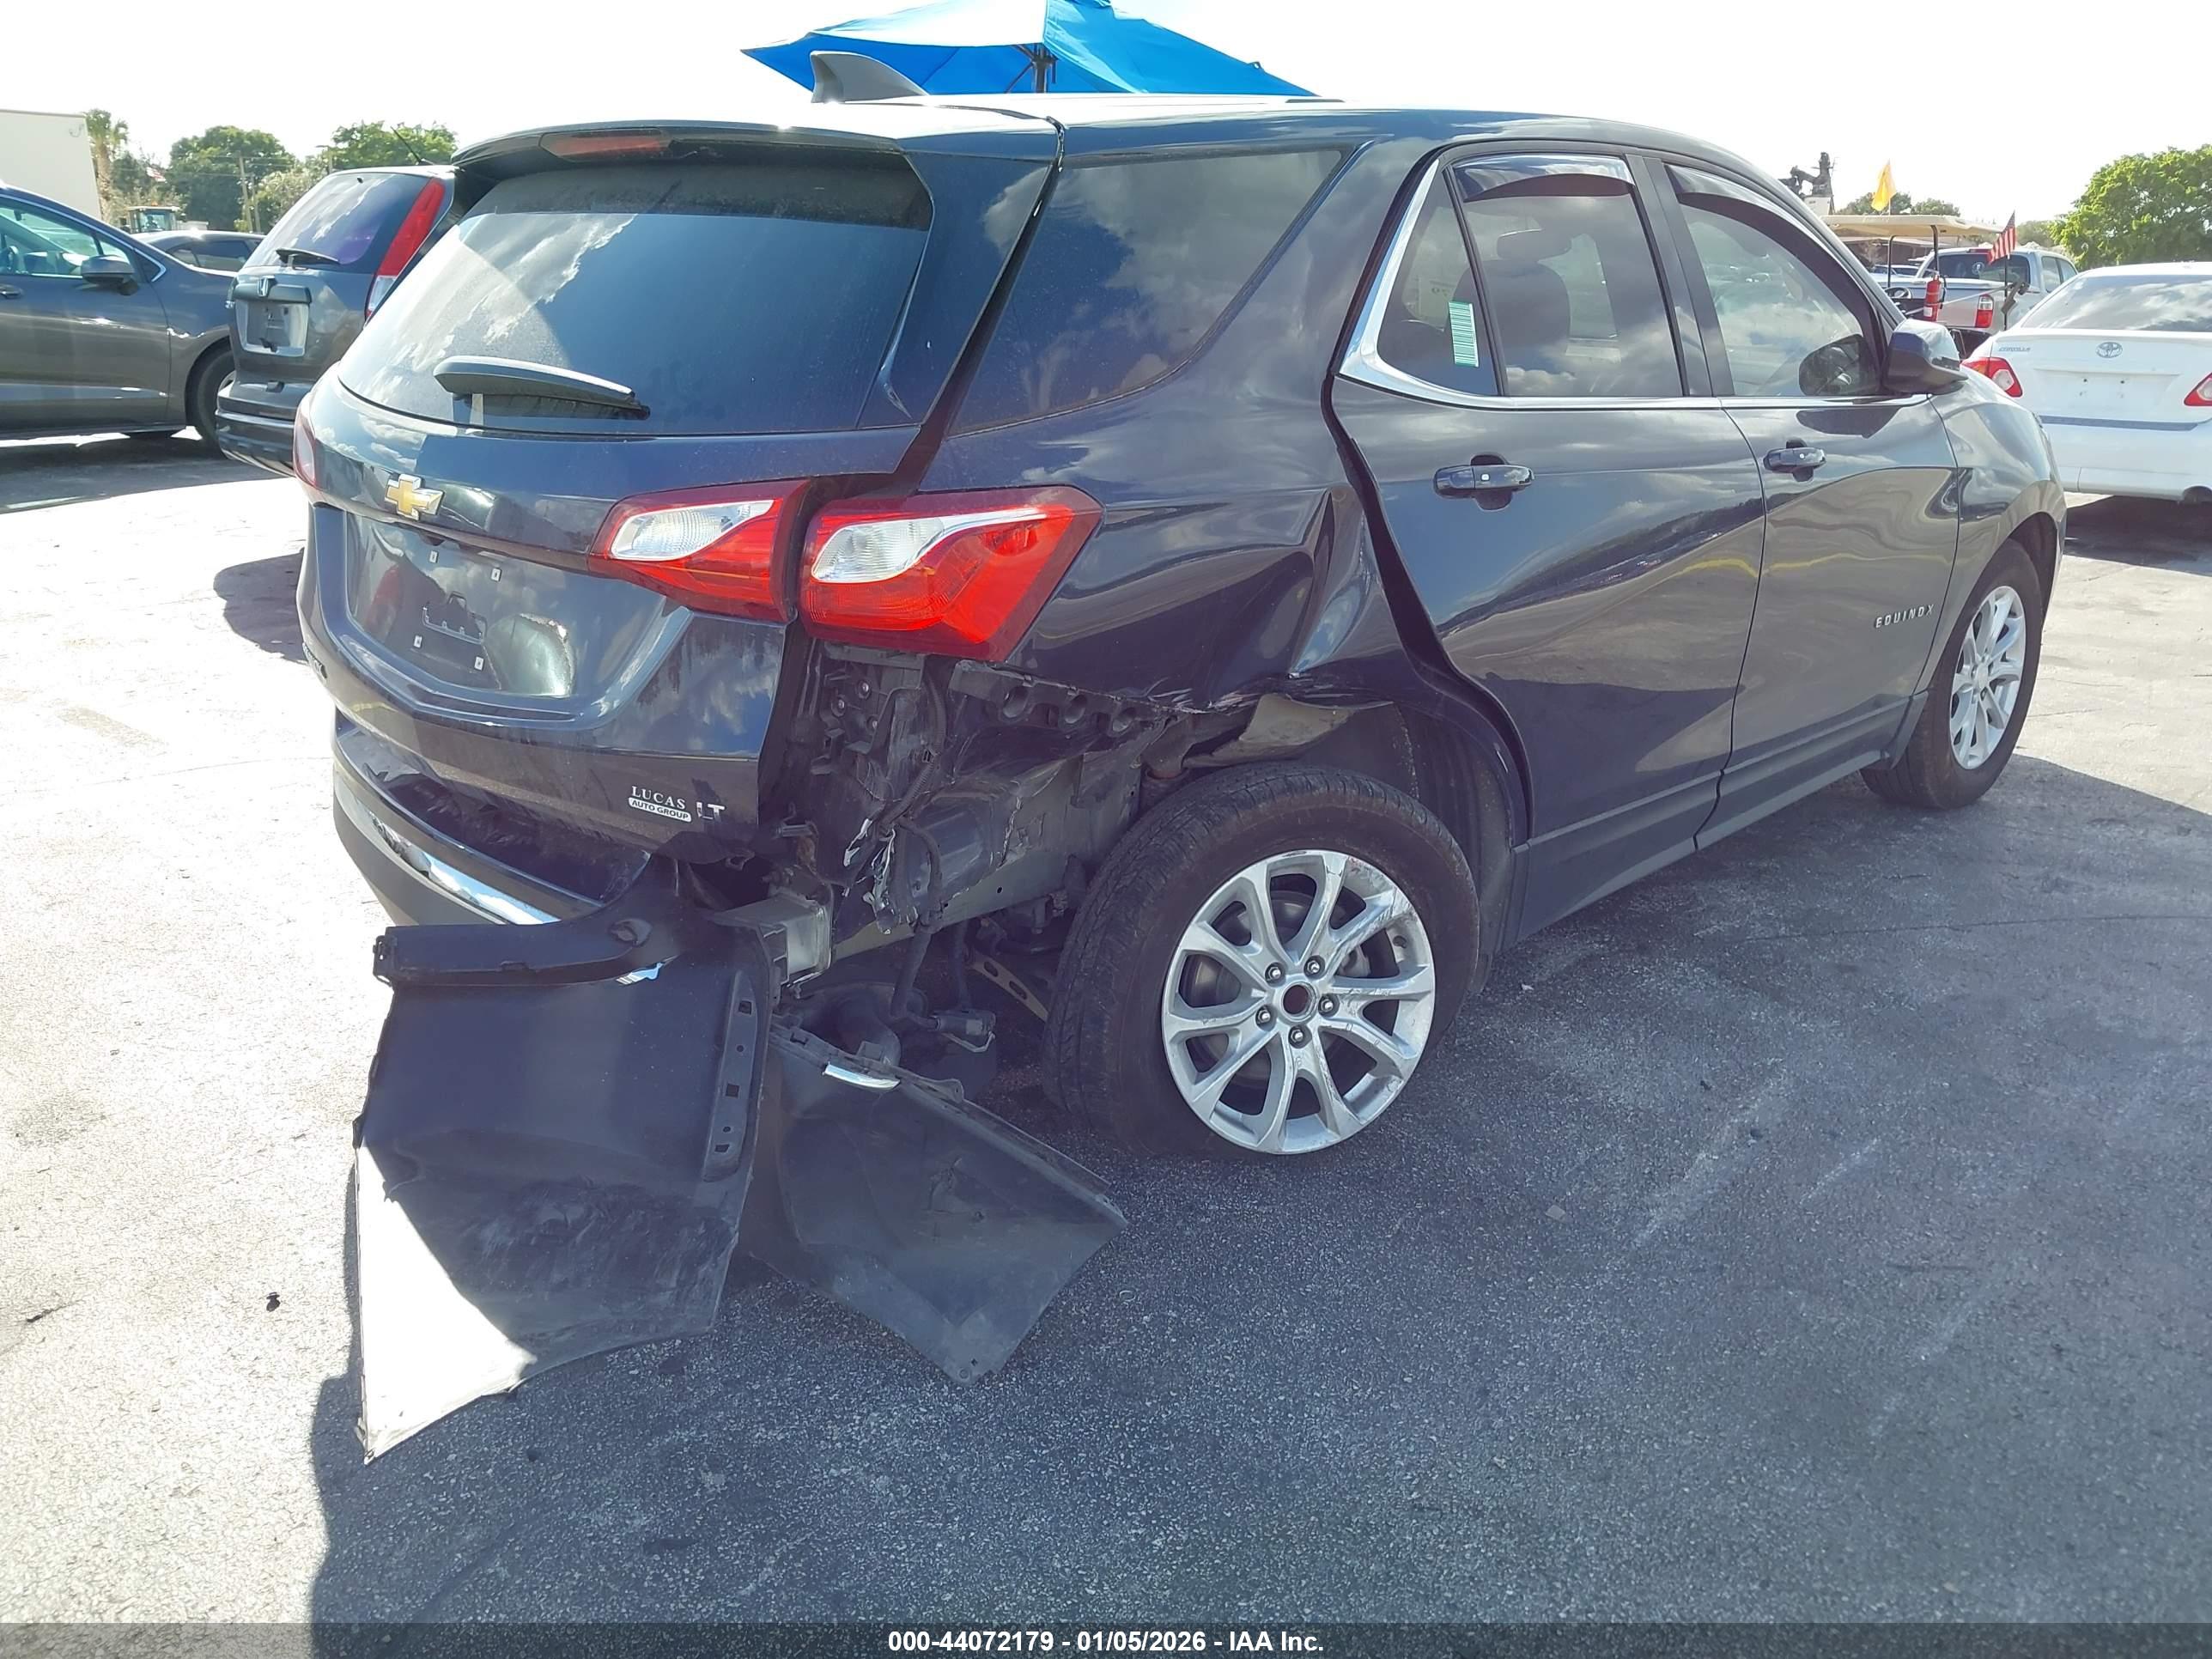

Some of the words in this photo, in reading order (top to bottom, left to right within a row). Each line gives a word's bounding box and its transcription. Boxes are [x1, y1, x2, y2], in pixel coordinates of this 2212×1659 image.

[1875, 604, 1934, 629] EQUINOX
[631, 785, 686, 810] LUCAS
[631, 799, 655, 811] AUTO
[657, 806, 689, 819] GROUP
[696, 801, 726, 821] LT
